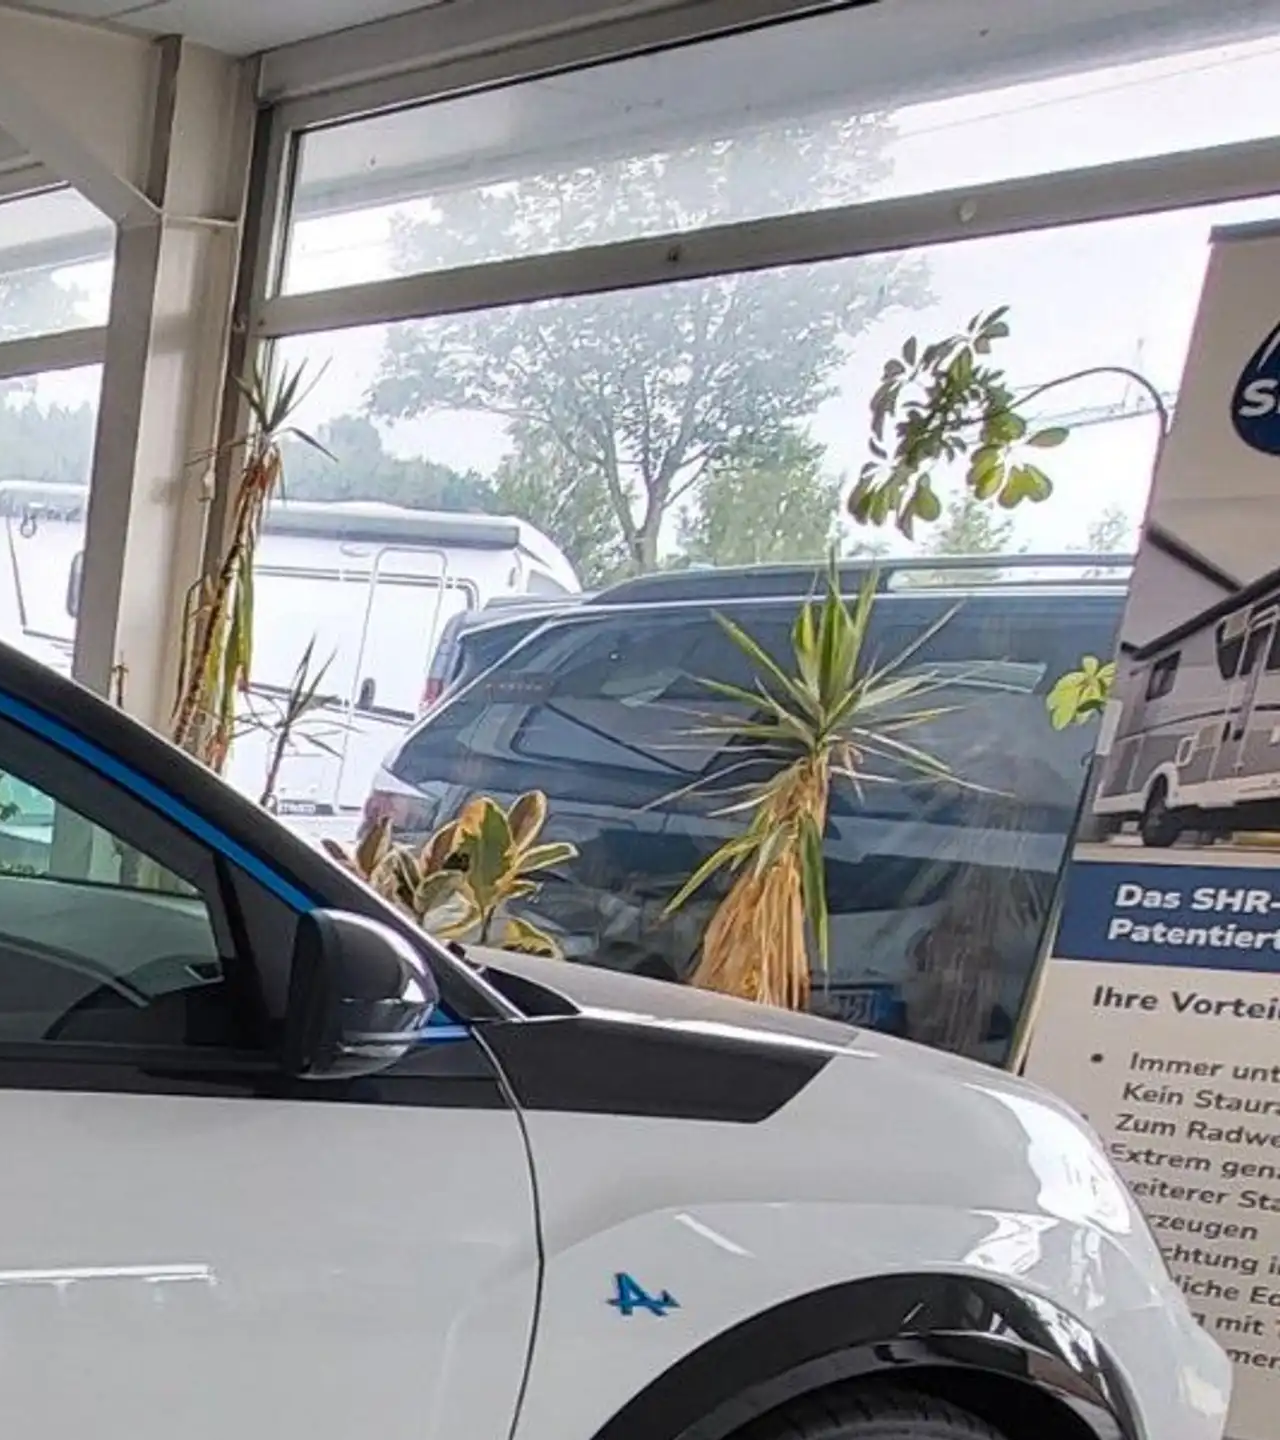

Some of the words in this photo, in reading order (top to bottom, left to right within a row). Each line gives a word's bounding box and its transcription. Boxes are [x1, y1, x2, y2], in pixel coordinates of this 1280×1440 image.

[1239, 378, 1280, 418] S
[1115, 883, 1181, 909] Das
[1191, 887, 1280, 914] SHR-
[1093, 985, 1158, 1012] Ihre
[1172, 991, 1280, 1020] Vortei
[1129, 1052, 1224, 1077] Immer
[1122, 1082, 1184, 1106] Kein
[1115, 1113, 1176, 1137] Zum
[1110, 1142, 1211, 1172] Extrem
[1221, 1160, 1280, 1179] gen
[1128, 1177, 1231, 1205] eiterer
[1215, 1315, 1265, 1336] mit
